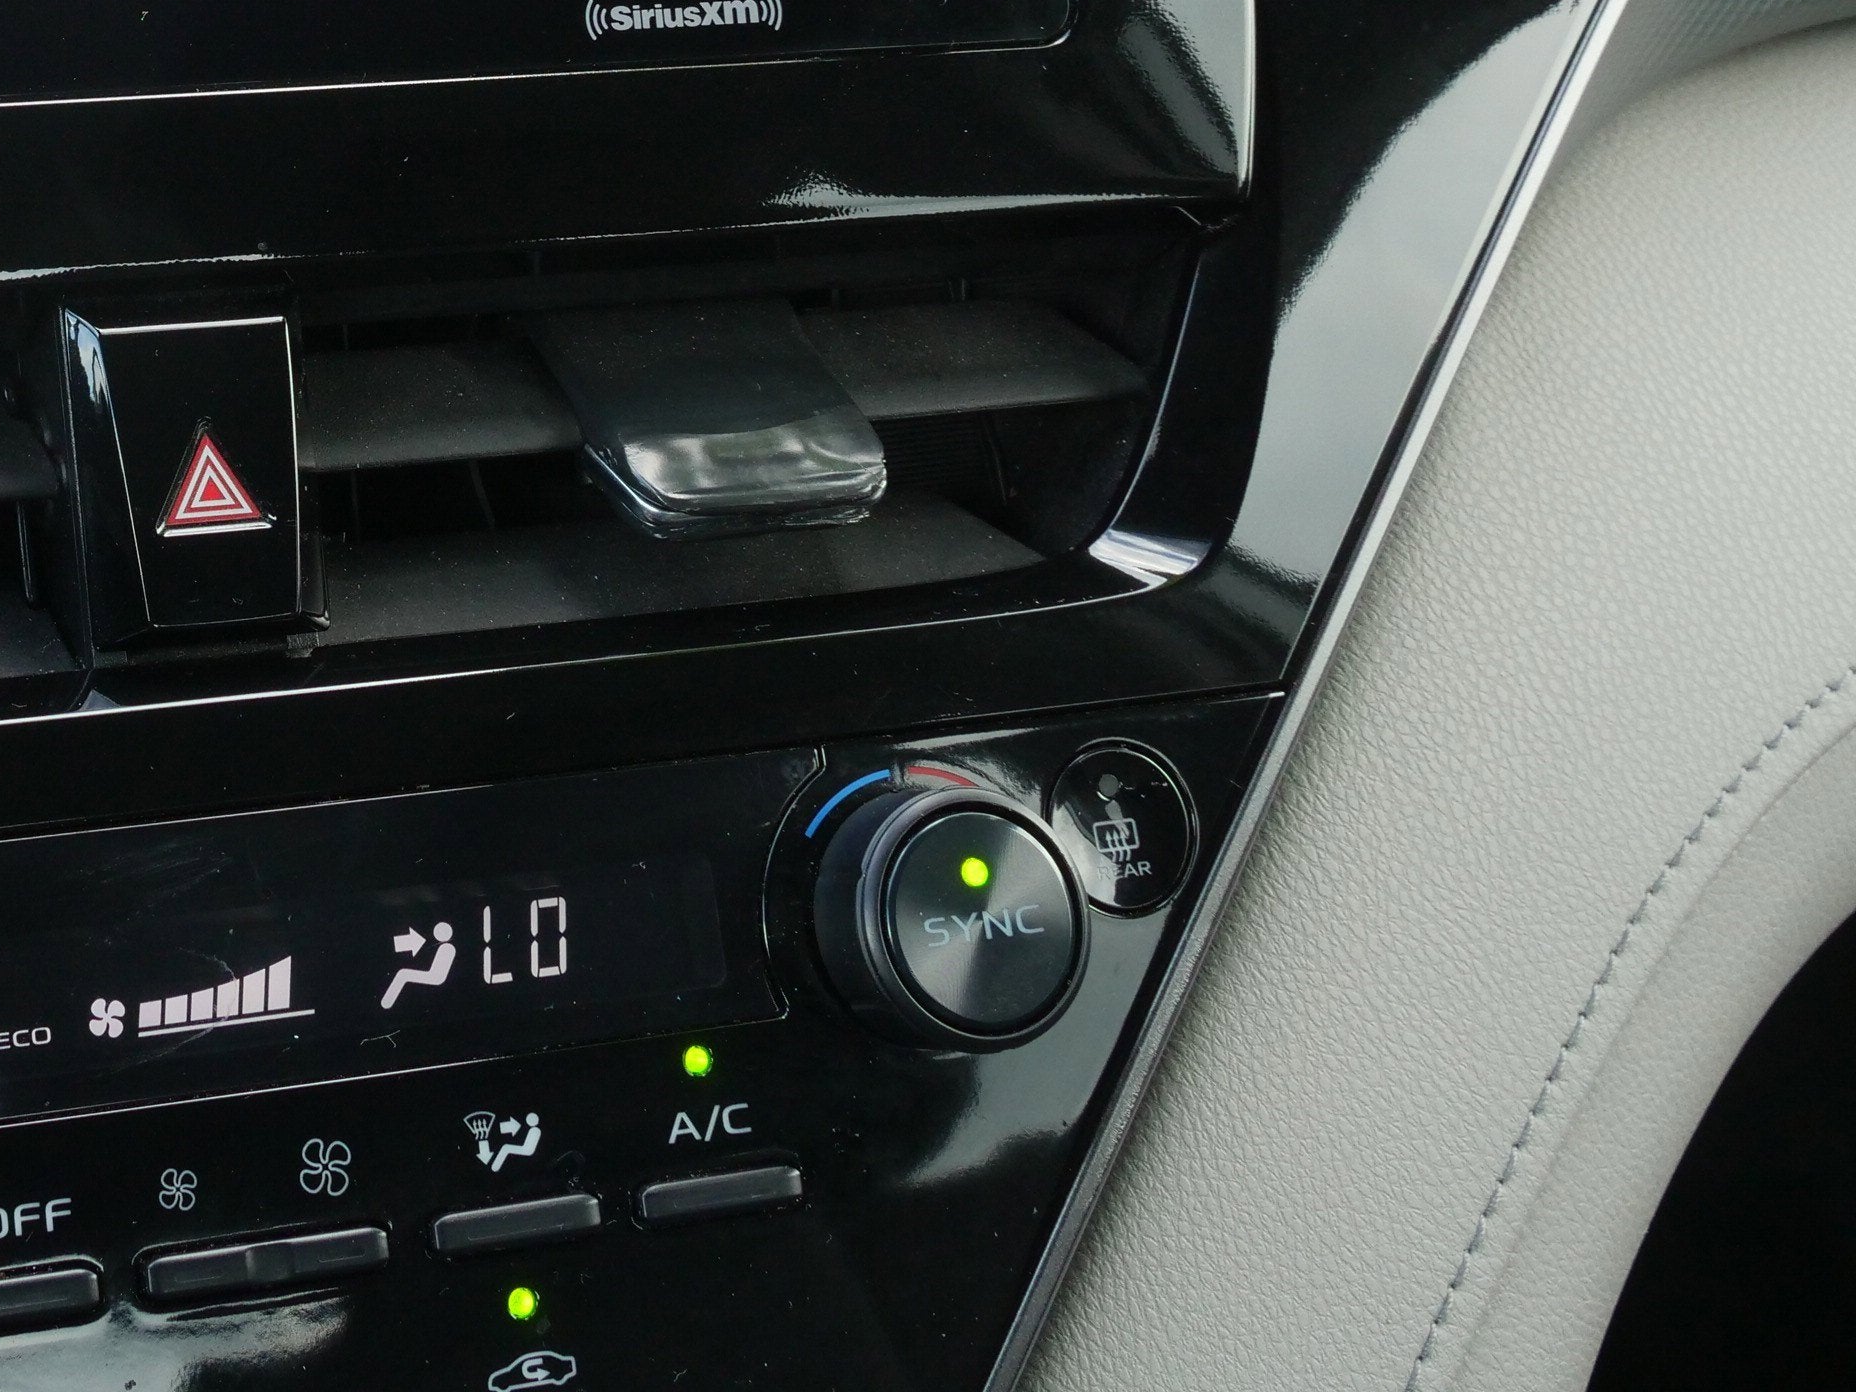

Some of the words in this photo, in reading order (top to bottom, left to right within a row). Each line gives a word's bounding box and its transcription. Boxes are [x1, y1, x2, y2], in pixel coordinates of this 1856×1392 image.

[1096, 860, 1152, 881] REAR
[924, 905, 1045, 947] SYNC
[668, 1103, 752, 1144] A/C
